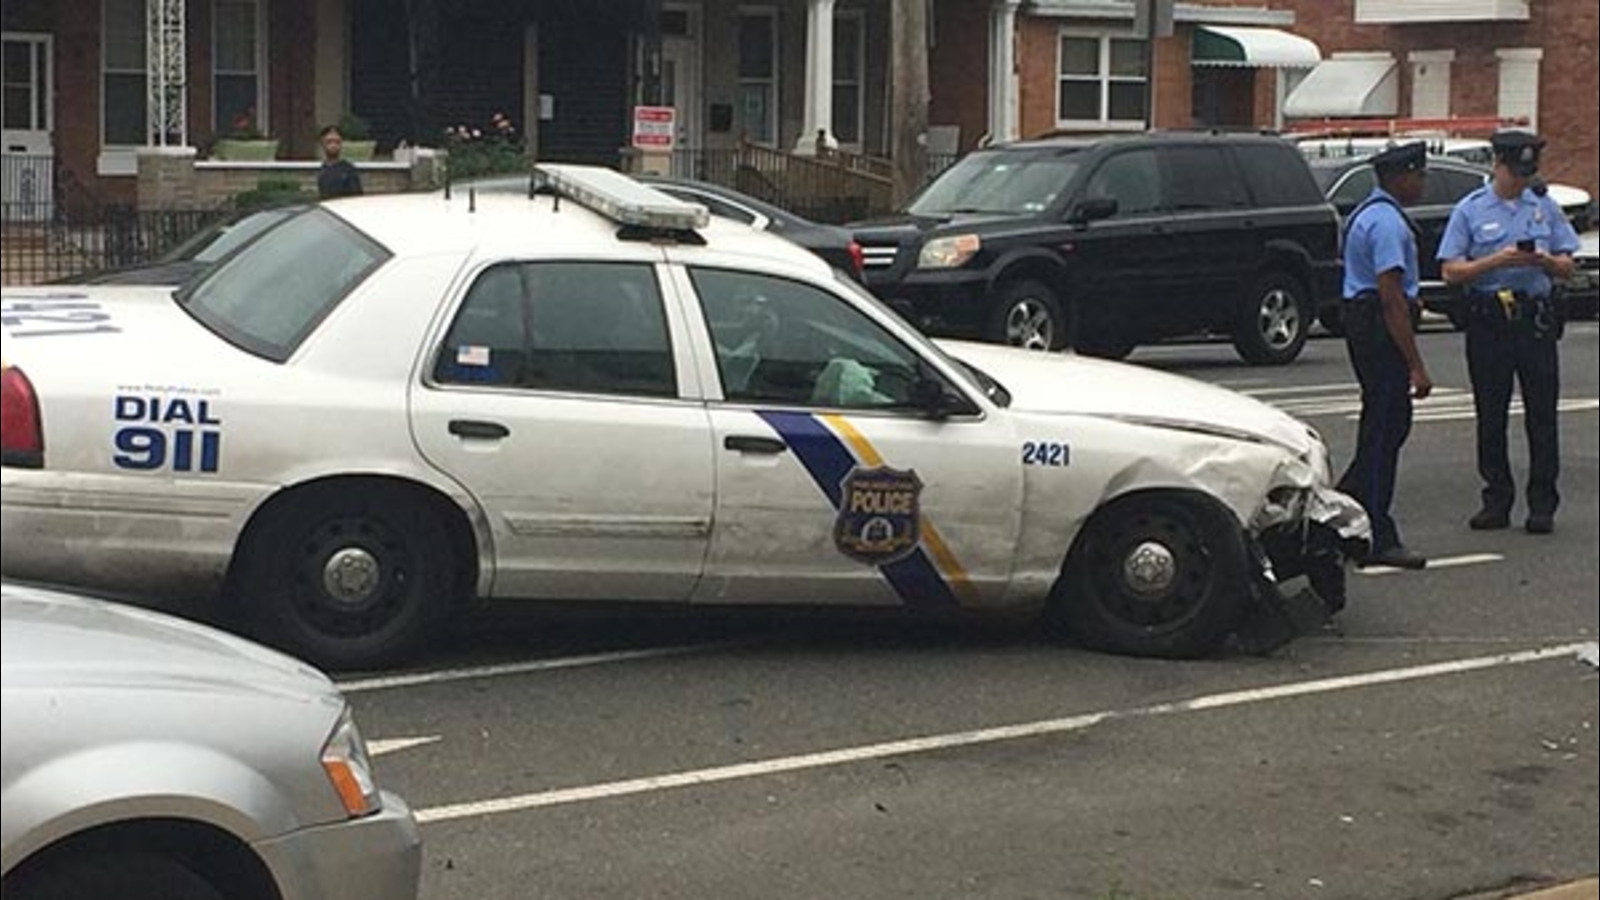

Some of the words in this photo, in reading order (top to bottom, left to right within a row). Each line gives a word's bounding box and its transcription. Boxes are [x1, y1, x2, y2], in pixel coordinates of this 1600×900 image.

[114, 396, 221, 425] DIAL
[113, 426, 220, 472] 911
[1023, 441, 1070, 467] 2421
[850, 490, 912, 514] POLICE
